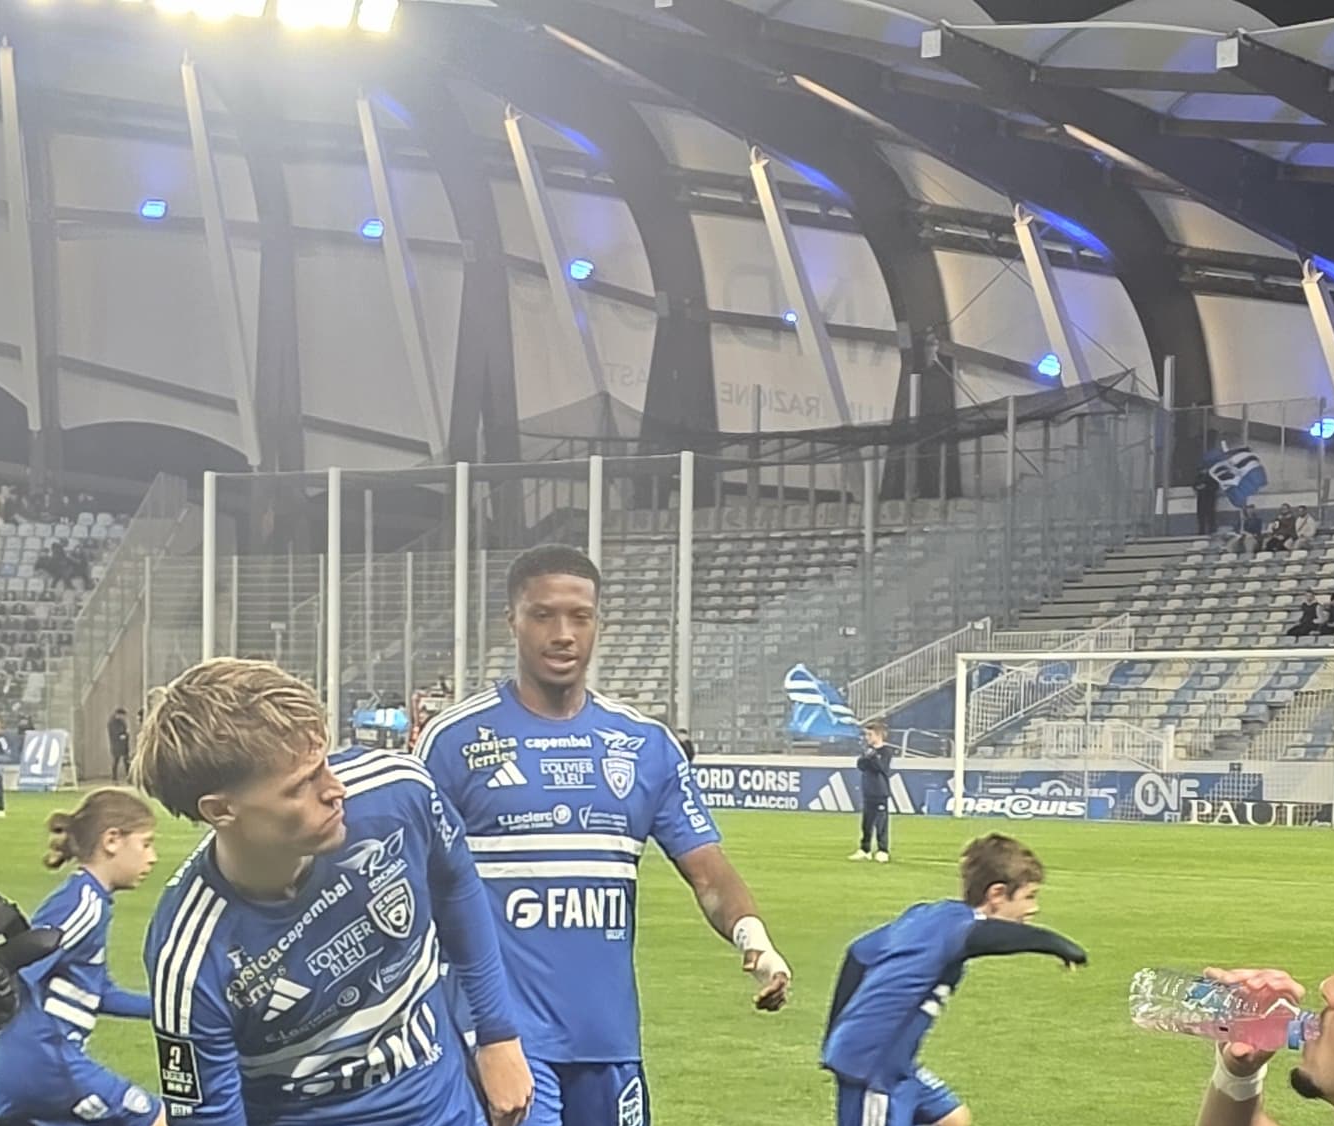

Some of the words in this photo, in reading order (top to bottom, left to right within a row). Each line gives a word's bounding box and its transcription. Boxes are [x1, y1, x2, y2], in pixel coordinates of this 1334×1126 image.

[553, 772, 585, 786] BLEU
[739, 769, 801, 793] CORSE
[744, 794, 799, 810] AJACCIO
[277, 873, 353, 951] capembal
[547, 887, 626, 929] FANTI
[307, 920, 375, 977] L'OLIVIER
[330, 943, 367, 977] BLEU
